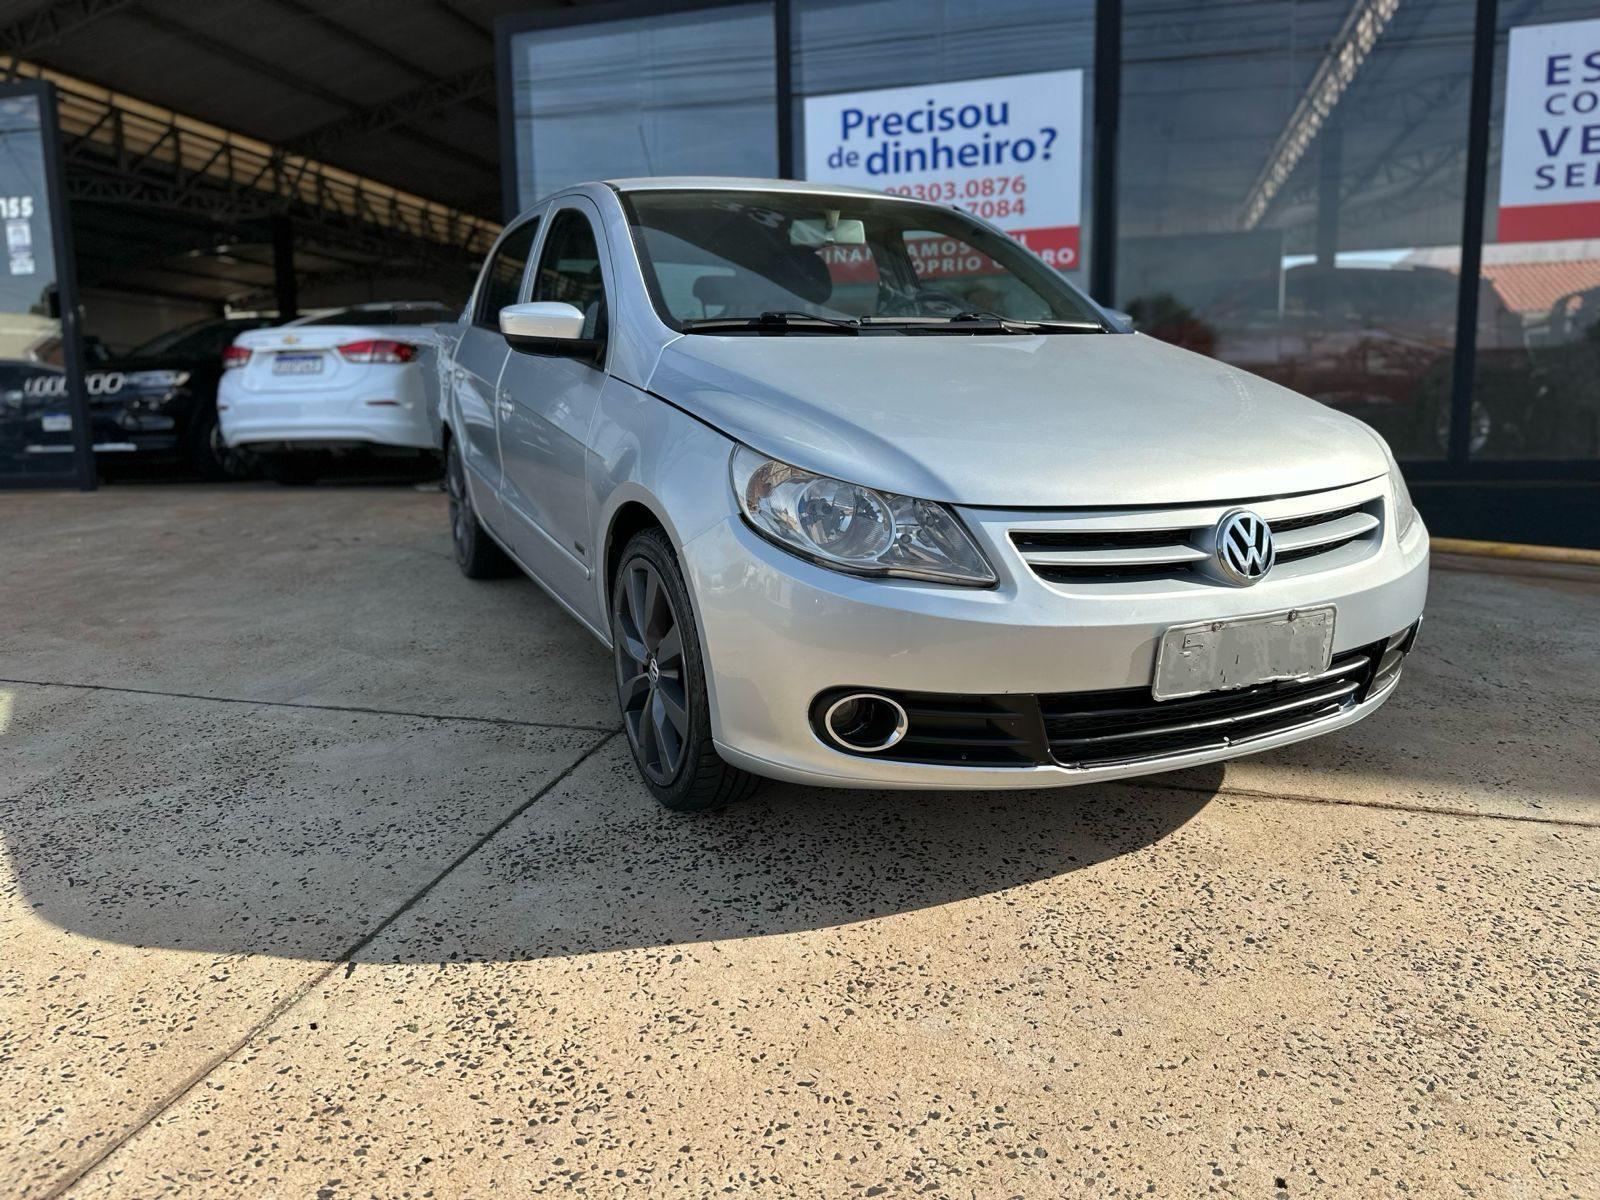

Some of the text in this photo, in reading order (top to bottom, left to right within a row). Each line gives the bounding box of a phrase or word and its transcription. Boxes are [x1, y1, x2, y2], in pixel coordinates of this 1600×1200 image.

[841, 100, 1009, 140] Precisou
[828, 128, 1057, 175] de dinheiro?
